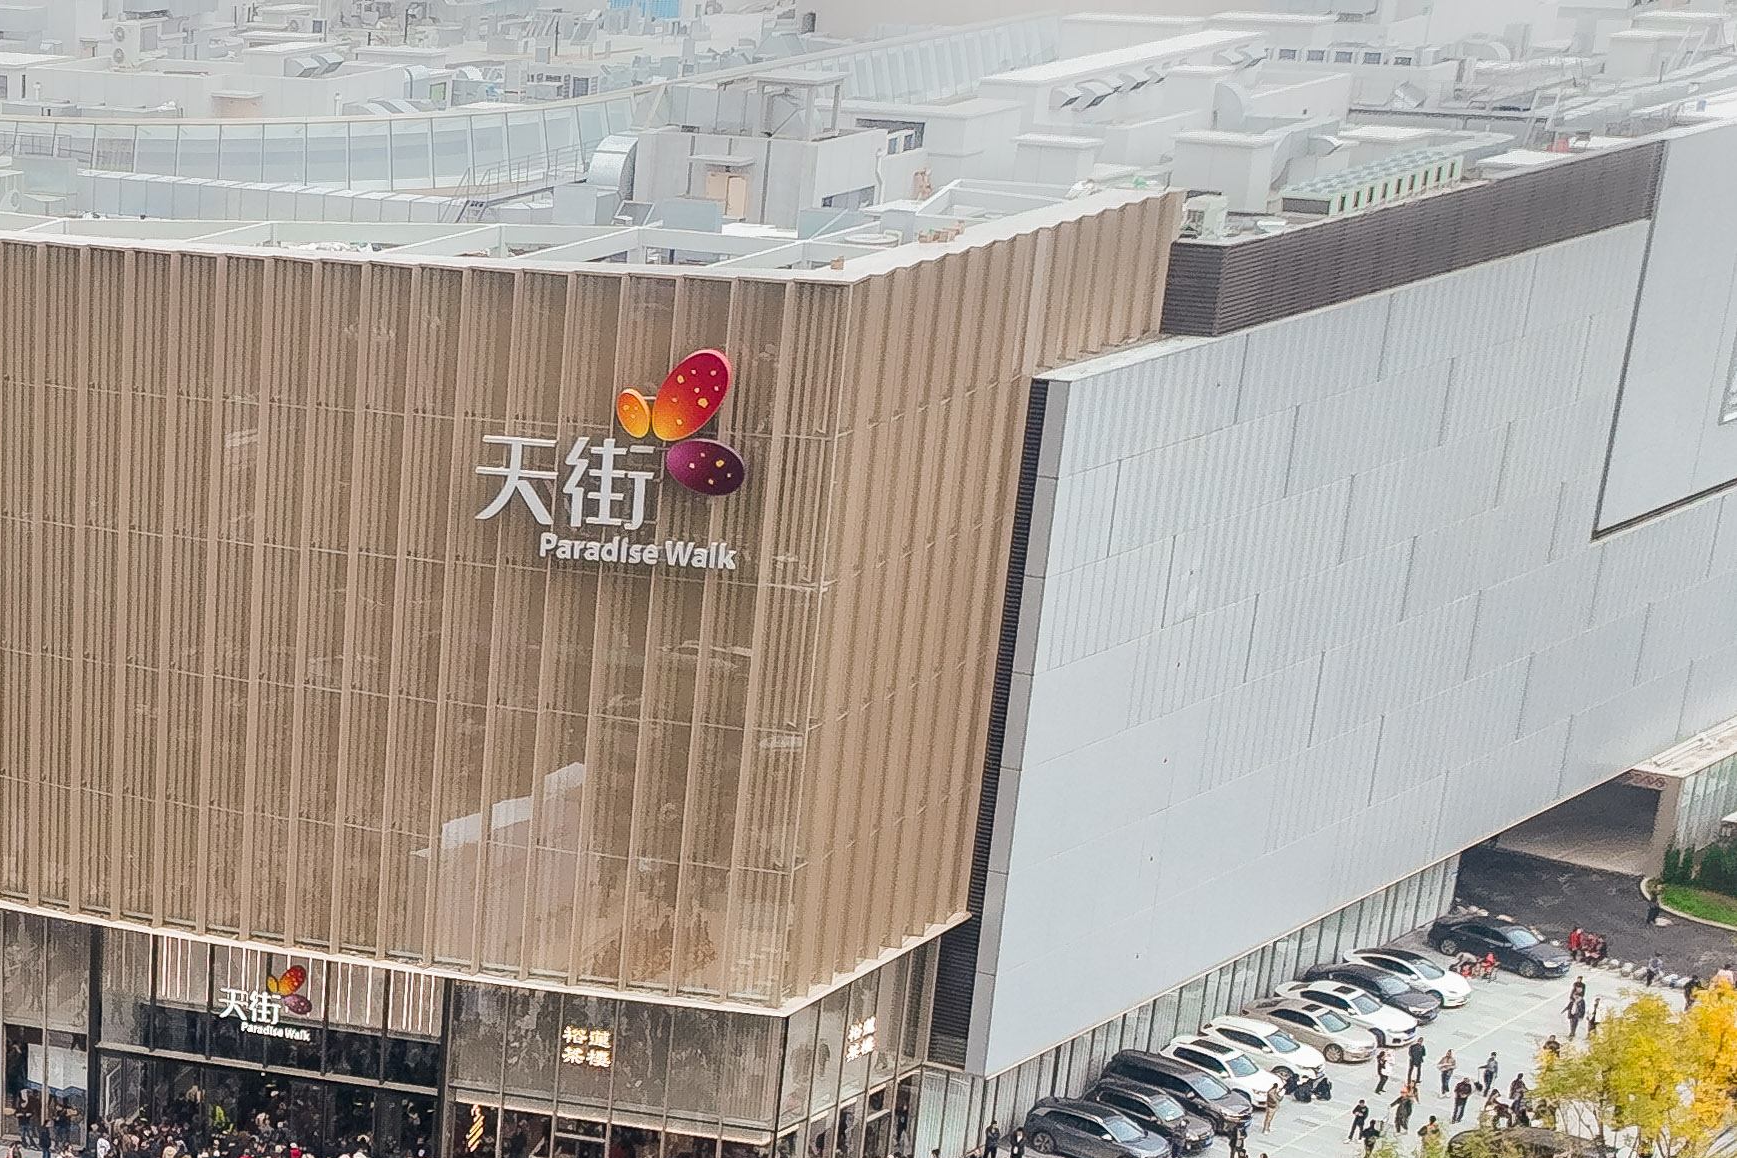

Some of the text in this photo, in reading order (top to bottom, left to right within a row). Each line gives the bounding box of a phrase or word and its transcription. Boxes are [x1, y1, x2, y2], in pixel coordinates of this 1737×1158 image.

[474, 434, 657, 531] 天街
[539, 532, 738, 571] Paradise Walk
[218, 987, 282, 1025] 天街
[240, 1021, 312, 1042] Paradise Walk
